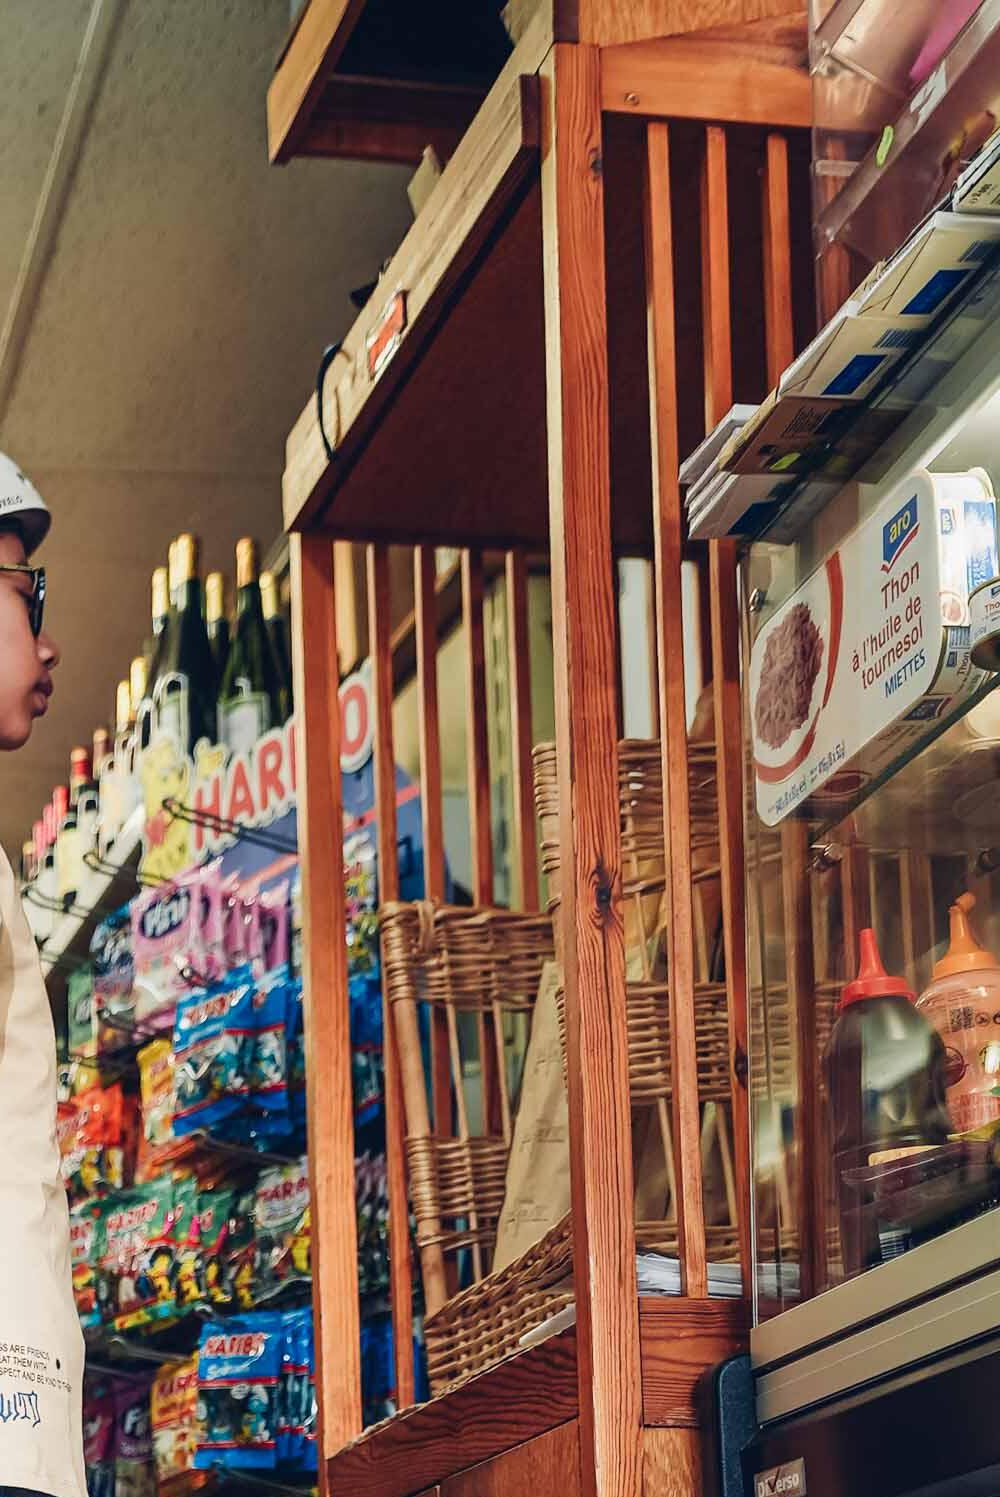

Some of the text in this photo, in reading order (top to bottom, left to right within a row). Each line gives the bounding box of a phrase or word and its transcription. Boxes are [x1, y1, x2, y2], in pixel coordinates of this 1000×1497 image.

[889, 510, 910, 543] aro
[881, 561, 920, 610] Thon
[861, 615, 924, 690] tournesol
[863, 615, 902, 662] l'huile
[905, 595, 921, 622] de
[884, 647, 926, 698] MIETTES
[195, 682, 368, 850] HARIO
[9, 1344, 25, 1354] ARE
[13, 1356, 33, 1368] THEM
[22, 1371, 36, 1382] AND
